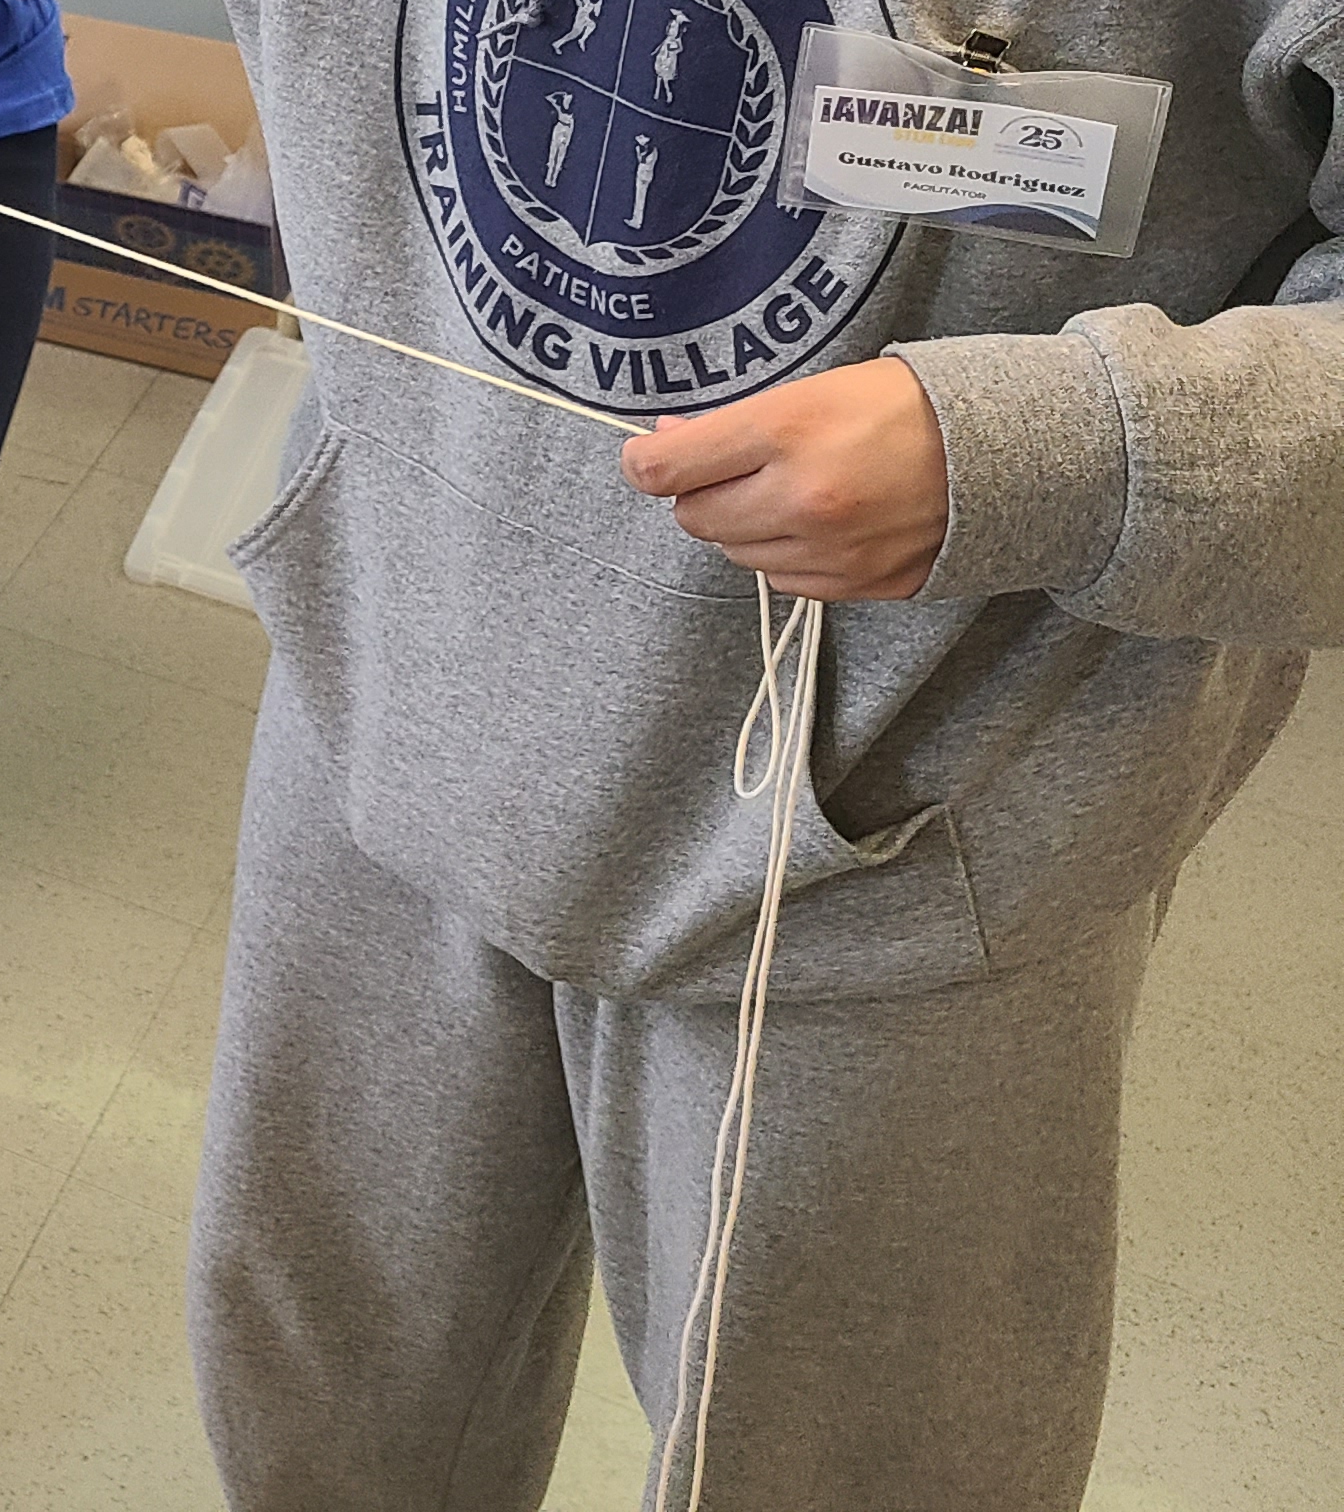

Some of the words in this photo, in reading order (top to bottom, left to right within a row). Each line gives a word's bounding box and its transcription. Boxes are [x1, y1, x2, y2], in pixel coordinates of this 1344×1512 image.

[1018, 125, 1065, 151] 25
[838, 151, 944, 176] Gustavo
[948, 163, 1087, 200] Rodriguez
[902, 180, 988, 201] FACILITATOR
[416, 90, 572, 372] TRAINING
[588, 255, 850, 395] VILLAGE
[501, 234, 655, 322] PATIENCE
[72, 296, 236, 349] STARTERS
